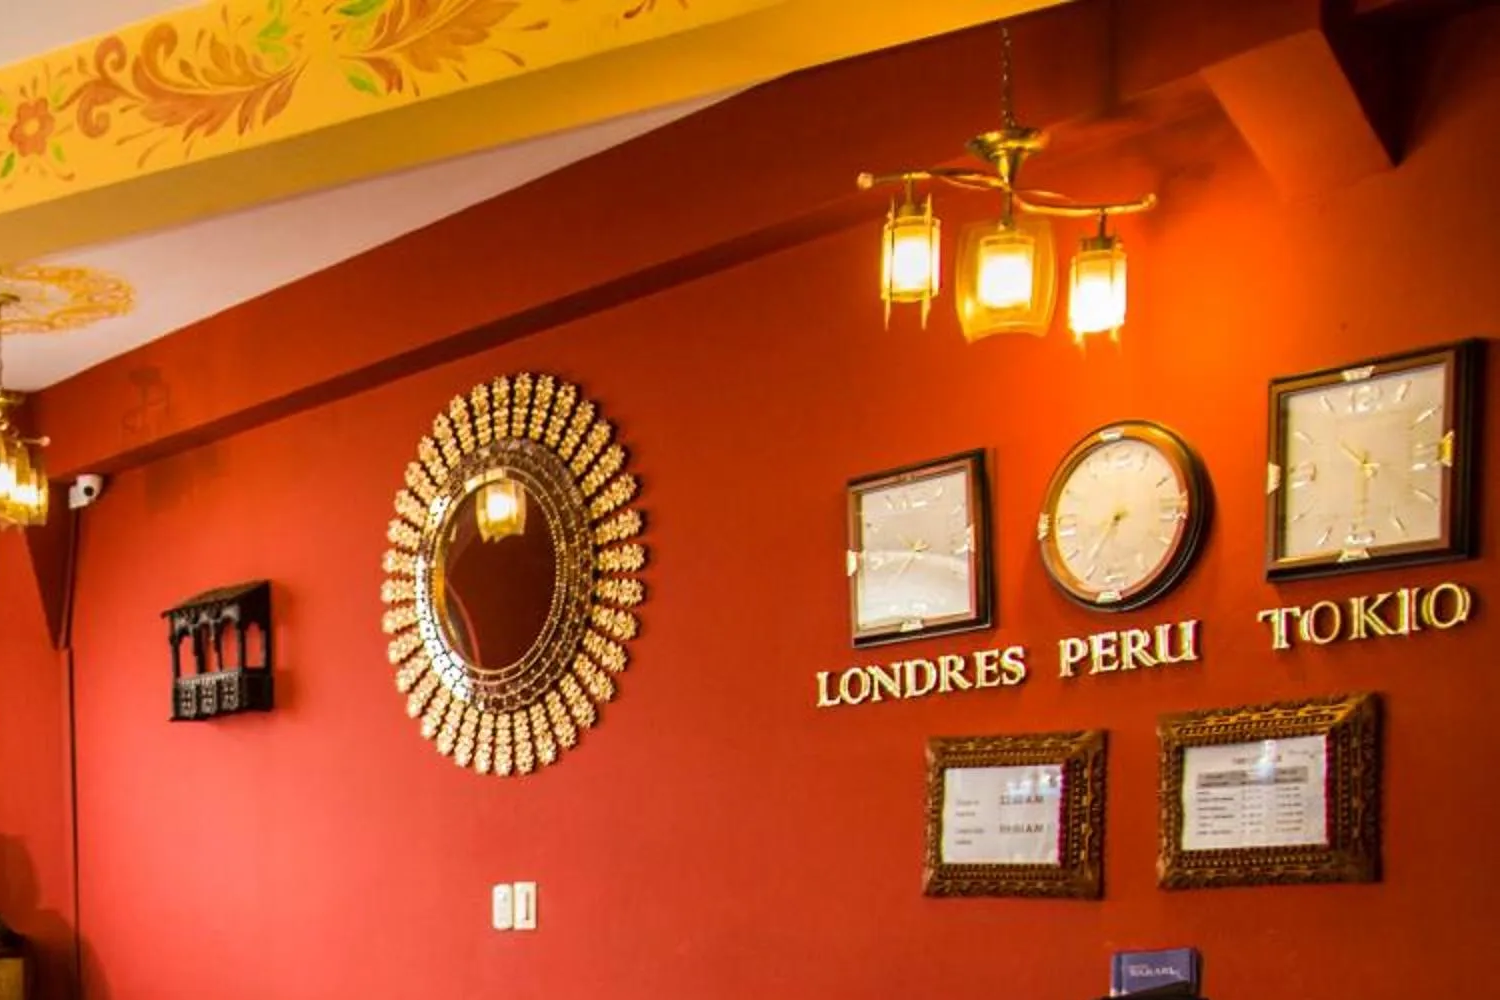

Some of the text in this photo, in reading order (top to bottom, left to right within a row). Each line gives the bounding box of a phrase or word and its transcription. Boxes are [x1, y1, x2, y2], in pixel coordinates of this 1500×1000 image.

[1257, 582, 1472, 650] TOKIO
[815, 645, 1027, 708] LONDRES
[1057, 619, 1200, 678] PERU
